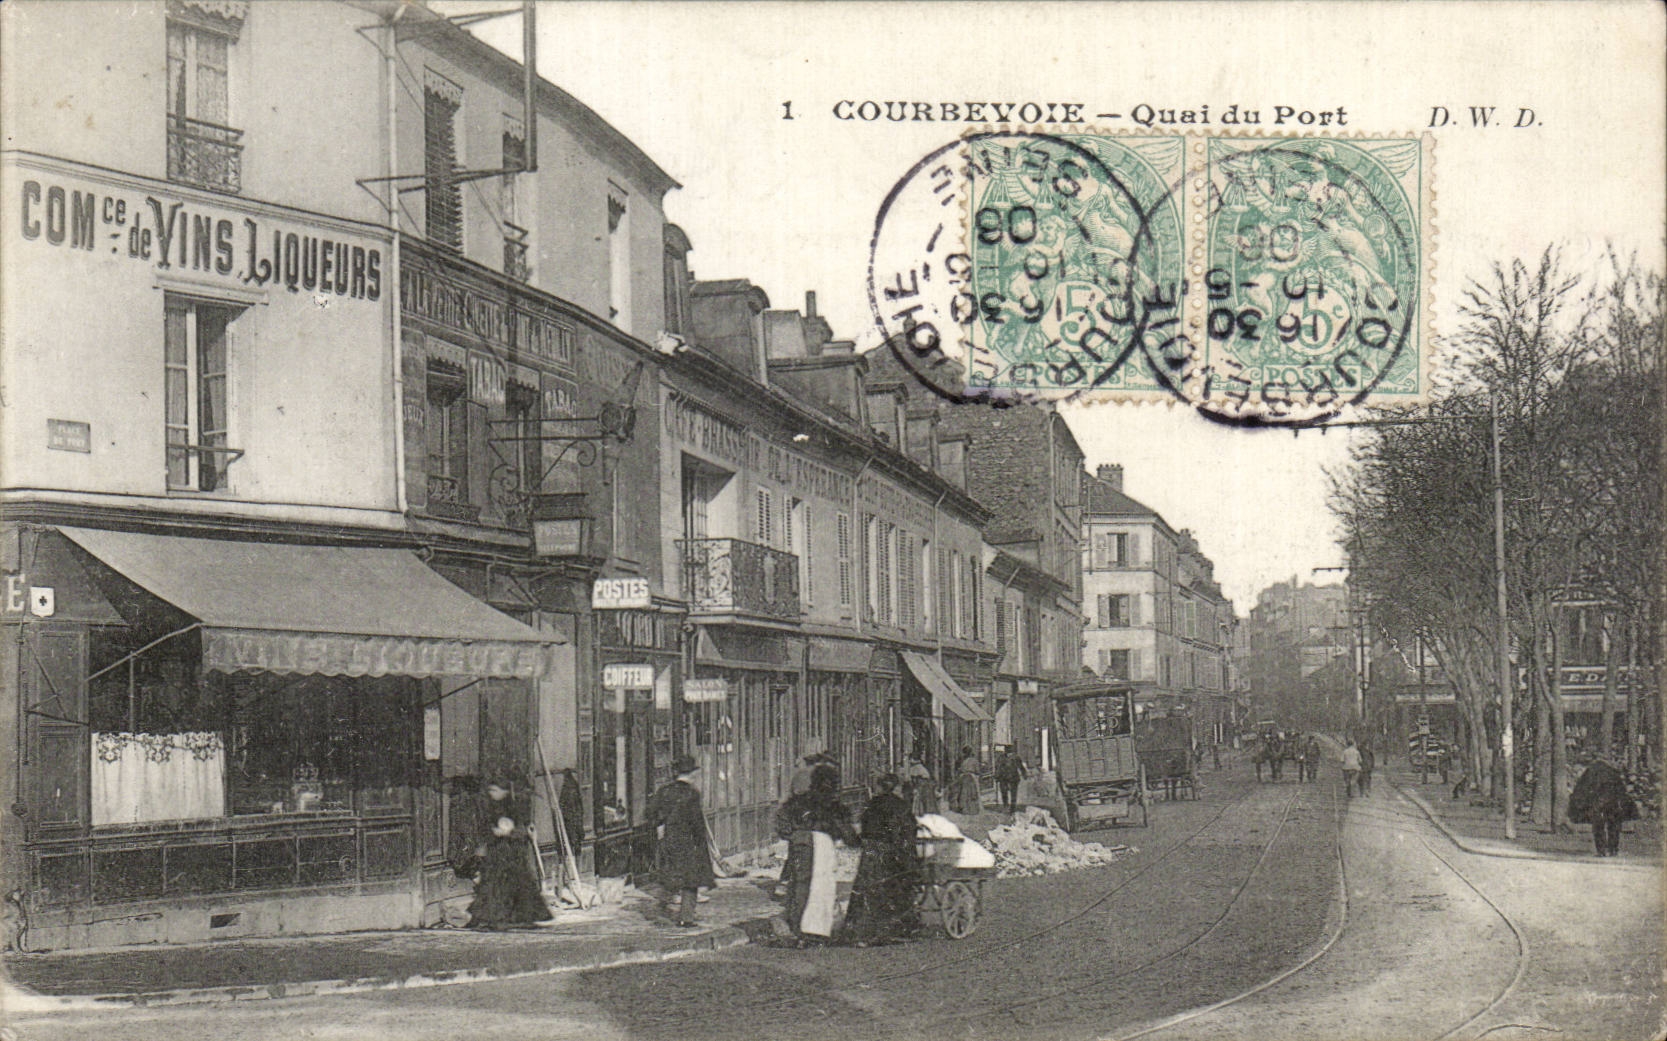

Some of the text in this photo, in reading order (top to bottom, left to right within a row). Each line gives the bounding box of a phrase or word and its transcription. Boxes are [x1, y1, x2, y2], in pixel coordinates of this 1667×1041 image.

[128, 212, 152, 260] de
[244, 217, 382, 301] LIQUEURS
[1207, 308, 1262, 341] 30
[469, 355, 507, 405] TABAC
[593, 577, 649, 599] POSTES
